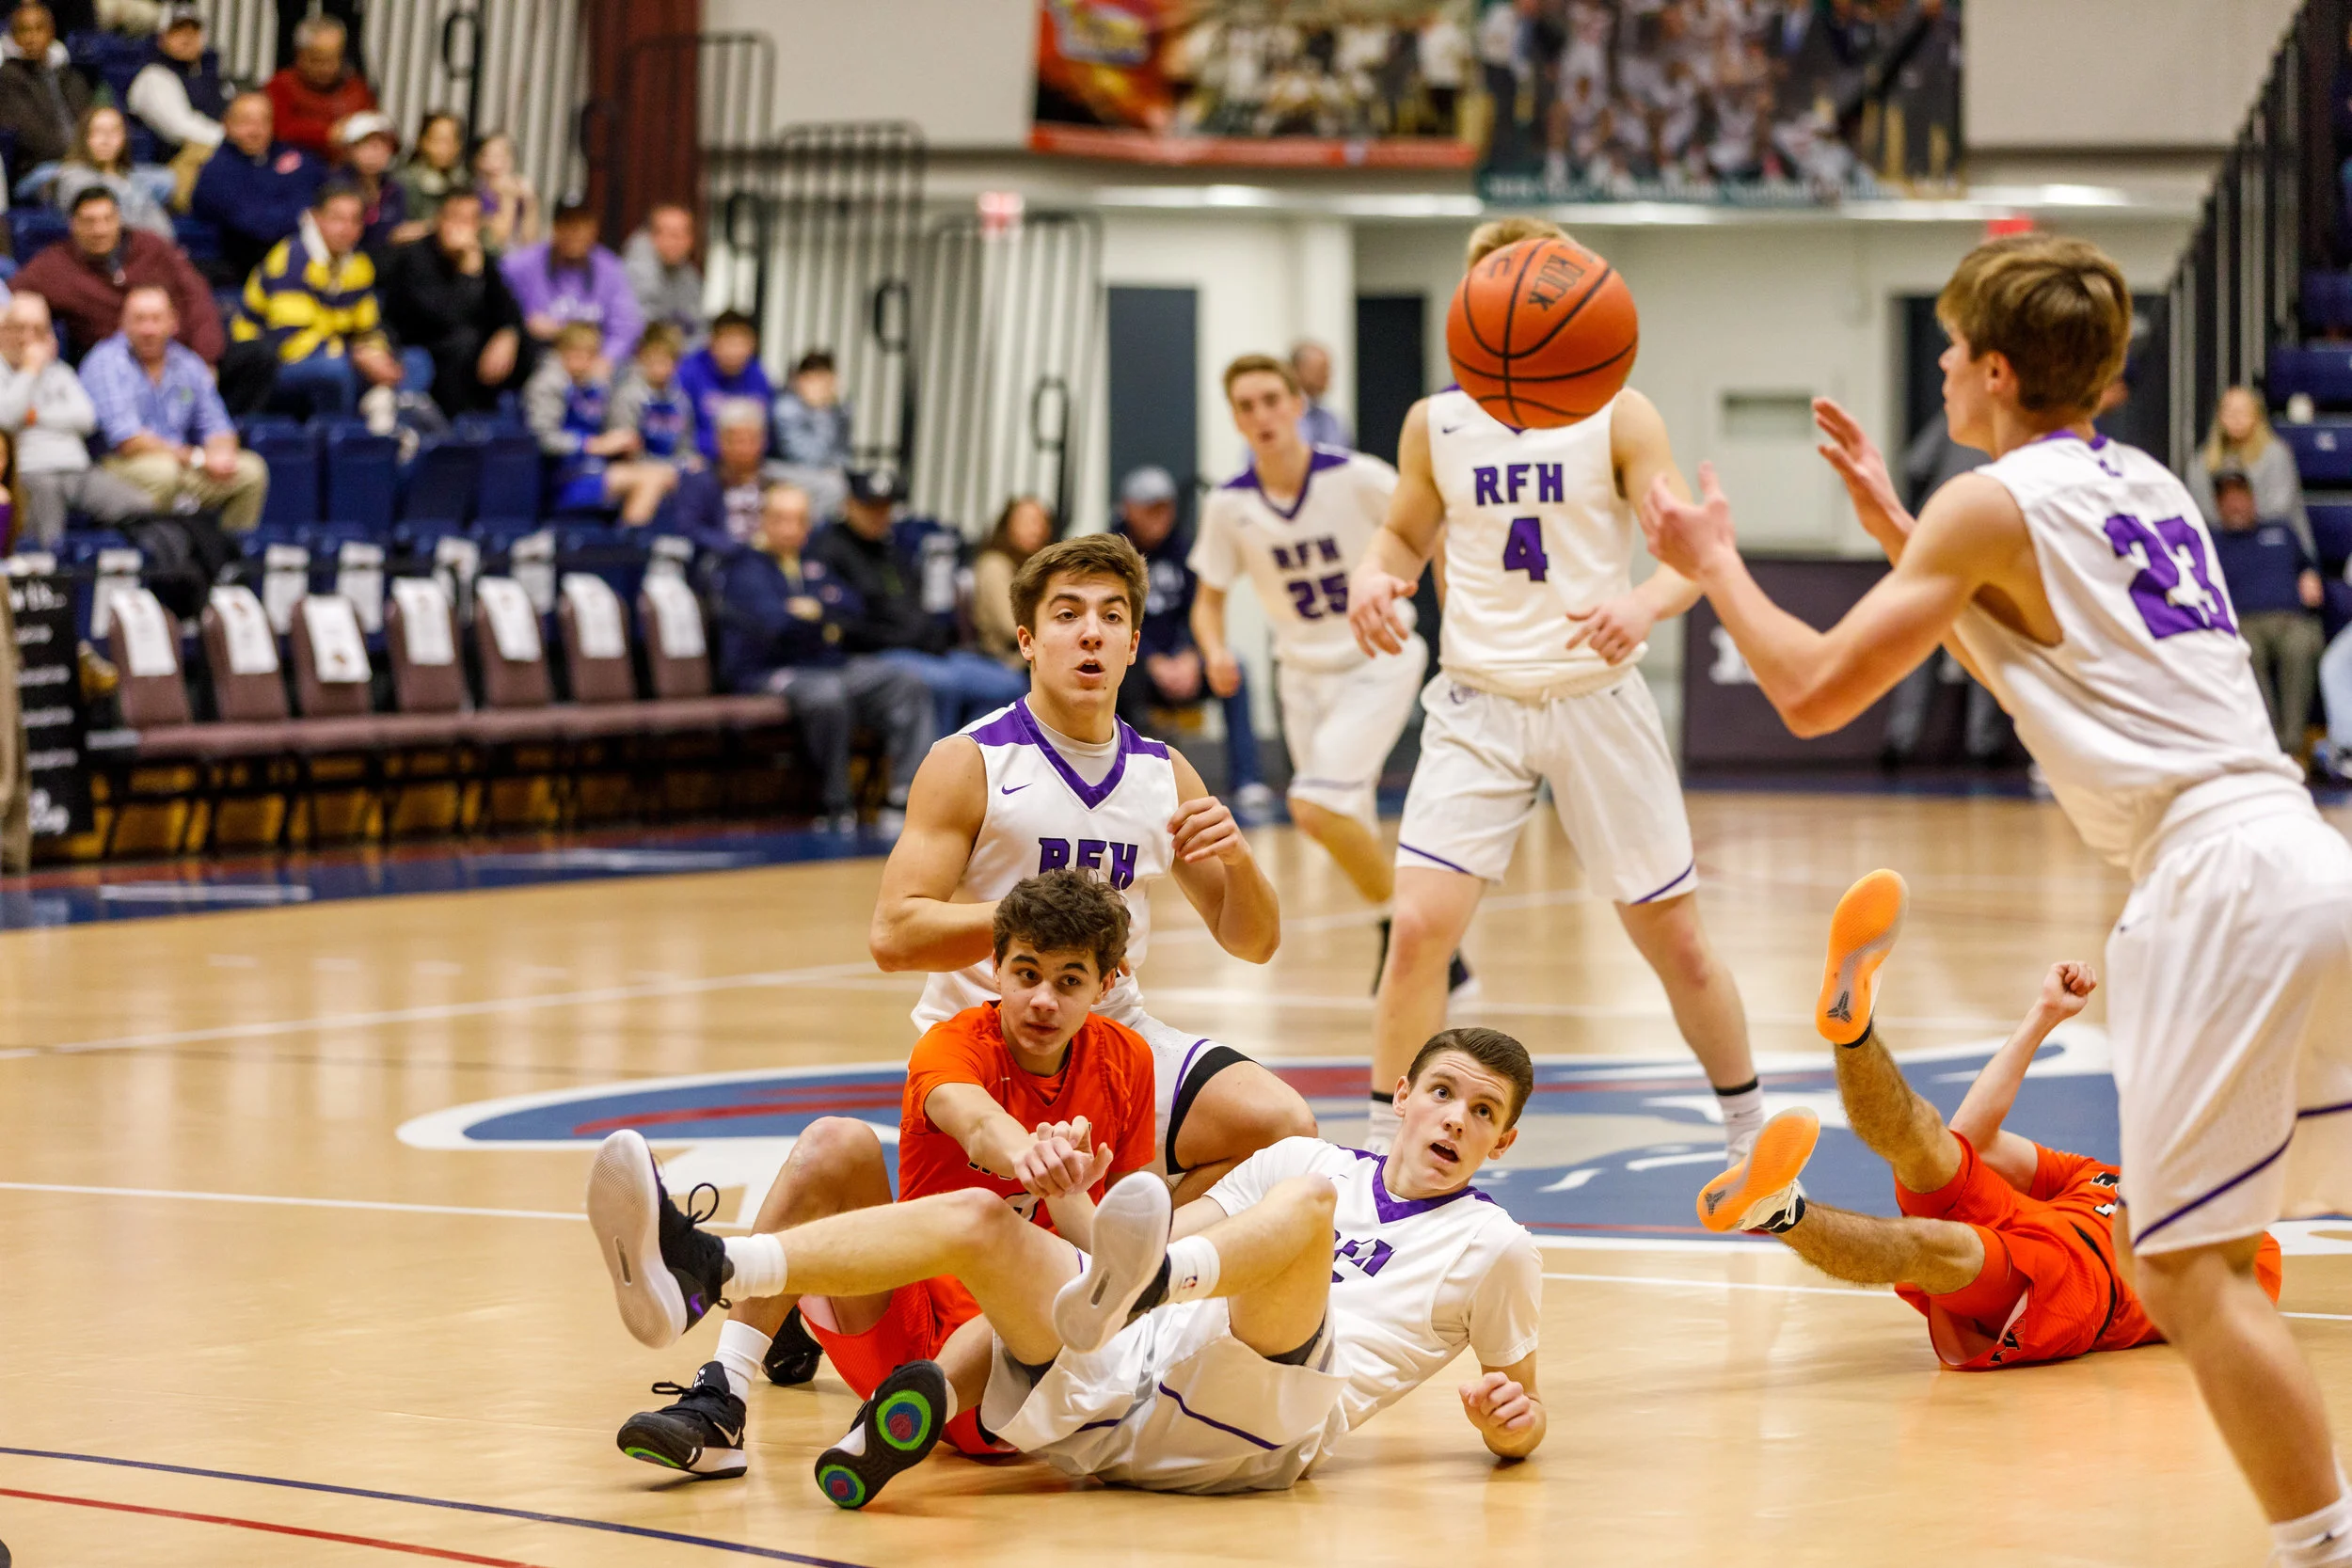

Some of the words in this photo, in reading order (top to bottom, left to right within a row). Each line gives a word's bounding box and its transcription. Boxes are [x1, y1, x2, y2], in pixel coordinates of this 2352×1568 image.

[1473, 463, 1564, 506] RFH
[1271, 535, 1342, 570] RFH
[1502, 517, 1549, 583] 4
[1286, 572, 1348, 621] 25
[2103, 514, 2237, 640] 23
[1038, 837, 1139, 892] RFH
